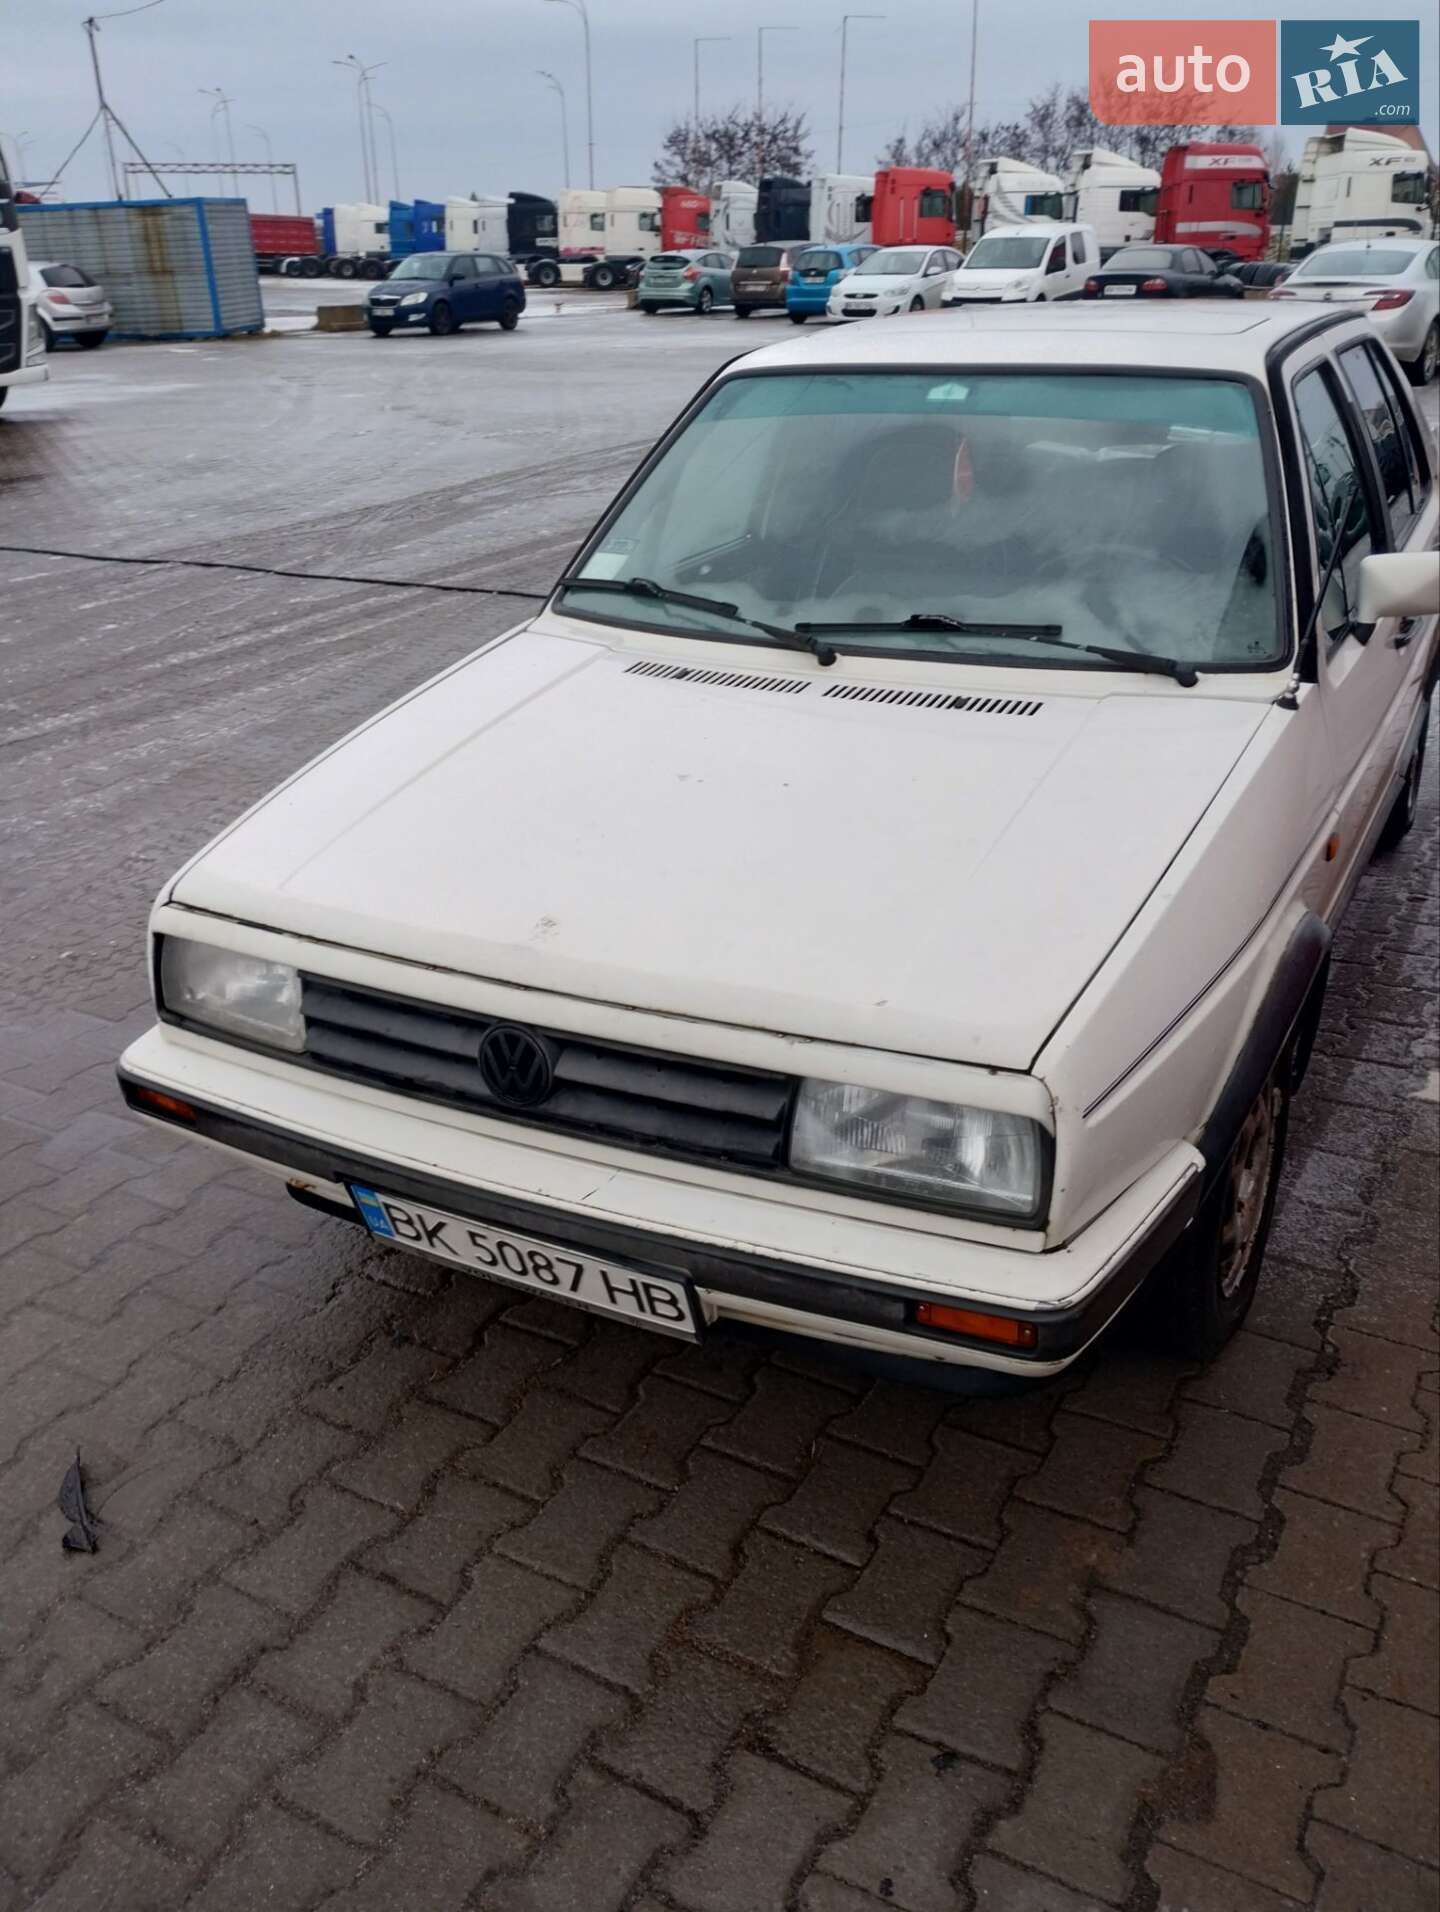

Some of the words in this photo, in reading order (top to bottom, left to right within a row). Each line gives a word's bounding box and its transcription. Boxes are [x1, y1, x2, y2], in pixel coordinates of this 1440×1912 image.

[384, 1203, 459, 1256] BK
[466, 1230, 584, 1293] 5087
[600, 1269, 686, 1323] HB
